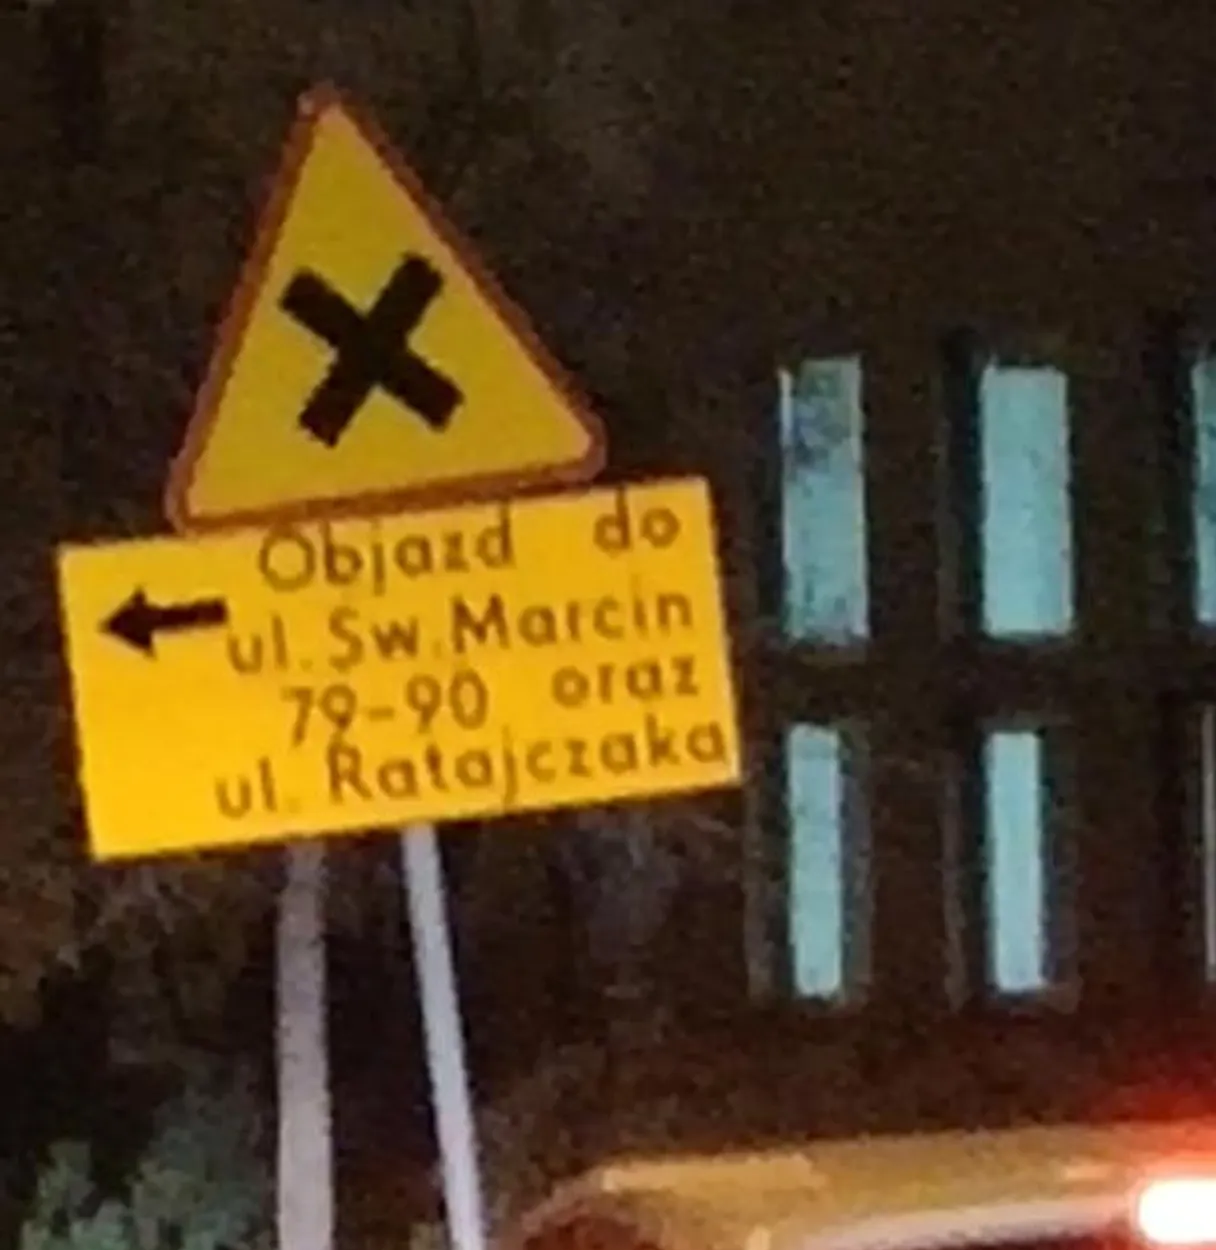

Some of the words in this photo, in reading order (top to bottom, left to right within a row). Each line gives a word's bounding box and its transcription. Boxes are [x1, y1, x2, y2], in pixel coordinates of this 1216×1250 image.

[259, 500, 515, 596] Objazd
[593, 483, 681, 557] do
[227, 609, 313, 674] ul.
[451, 573, 692, 654] Marcin
[281, 666, 488, 747] 79-90
[552, 656, 698, 709] oraz
[216, 755, 302, 820] ul.
[327, 713, 726, 806] Ratajczaka
